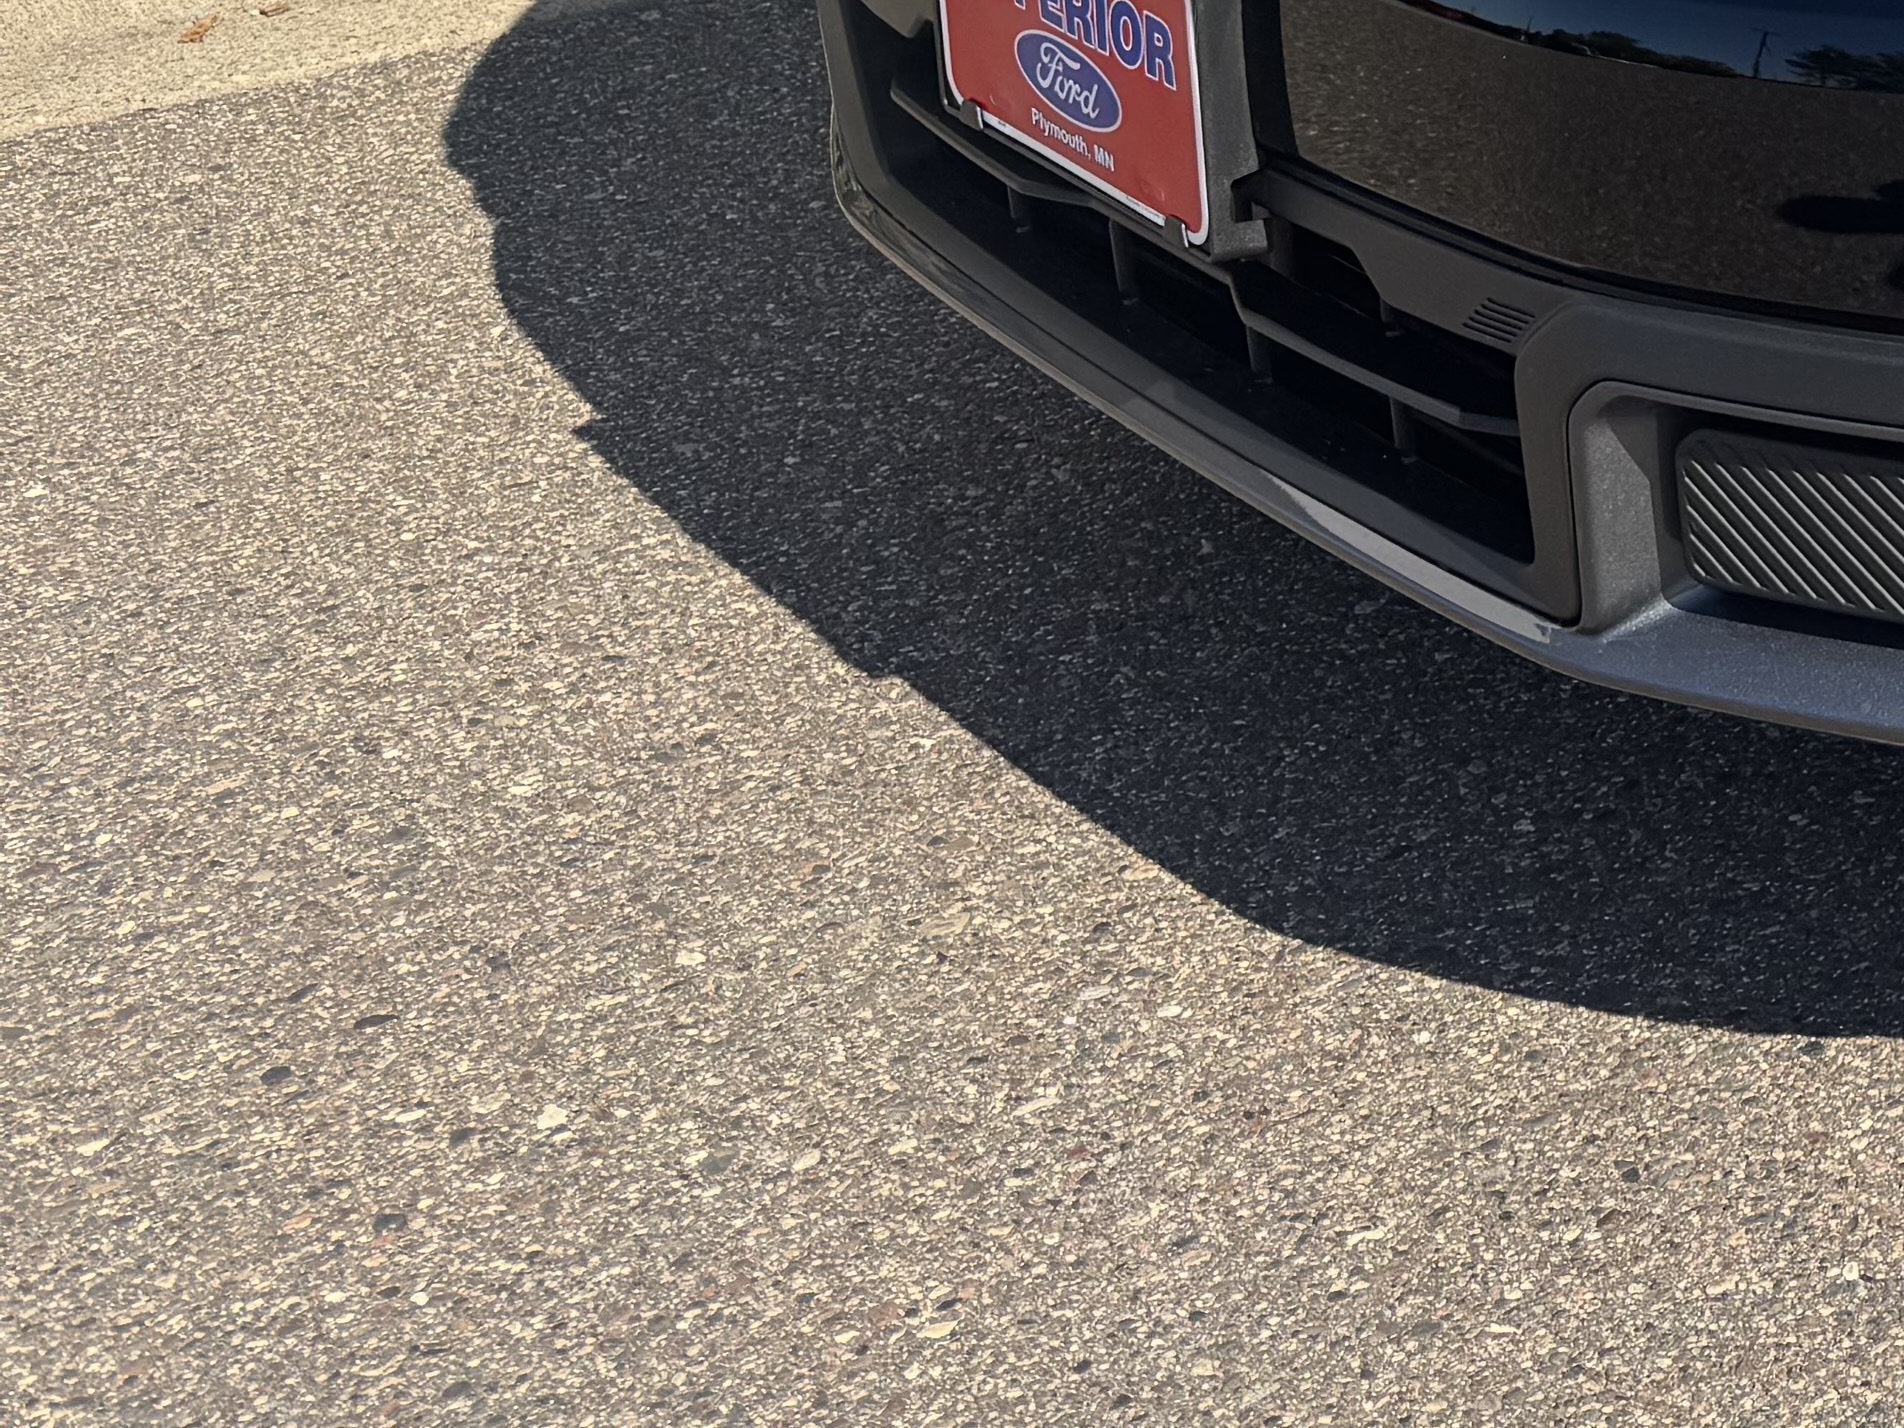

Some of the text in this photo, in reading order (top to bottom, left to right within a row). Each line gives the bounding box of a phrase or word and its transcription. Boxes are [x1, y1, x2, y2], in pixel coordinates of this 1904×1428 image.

[1036, 42, 1100, 119] Ford
[1031, 108, 1115, 172] Plymouth, MN
